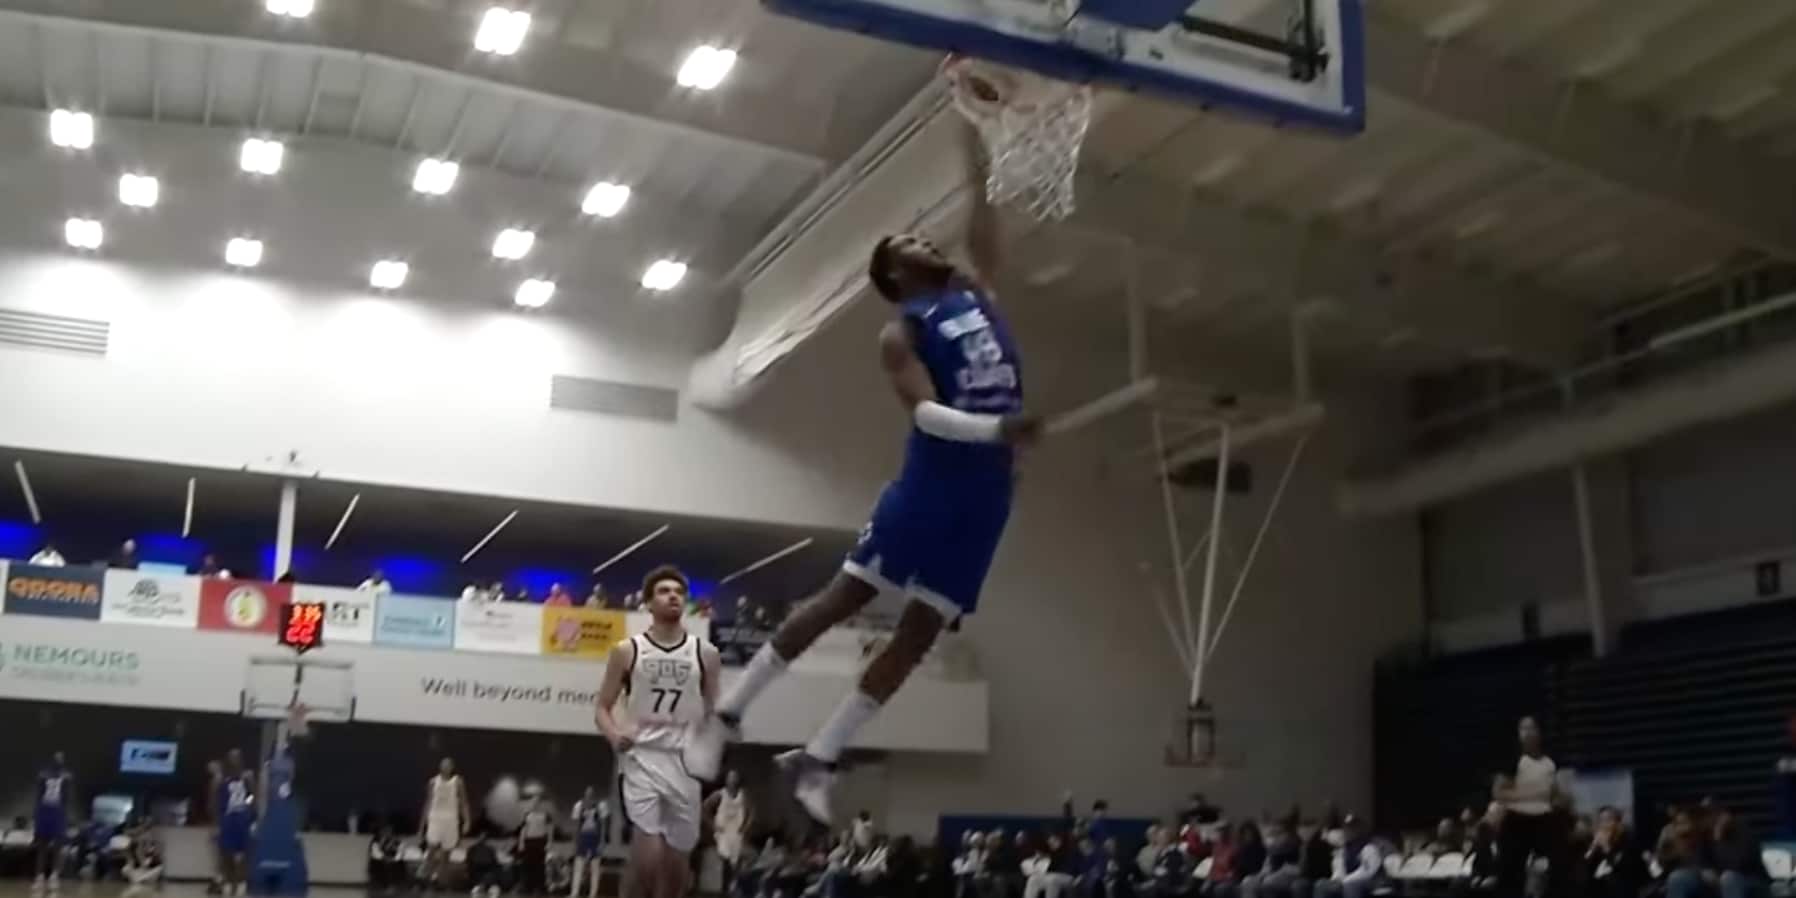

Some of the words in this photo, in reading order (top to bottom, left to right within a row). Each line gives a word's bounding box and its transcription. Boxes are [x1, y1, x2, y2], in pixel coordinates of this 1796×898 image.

[14, 643, 140, 670] NEMOURS
[421, 676, 468, 697] Well
[473, 680, 552, 703] beyond
[651, 688, 682, 713] 77
